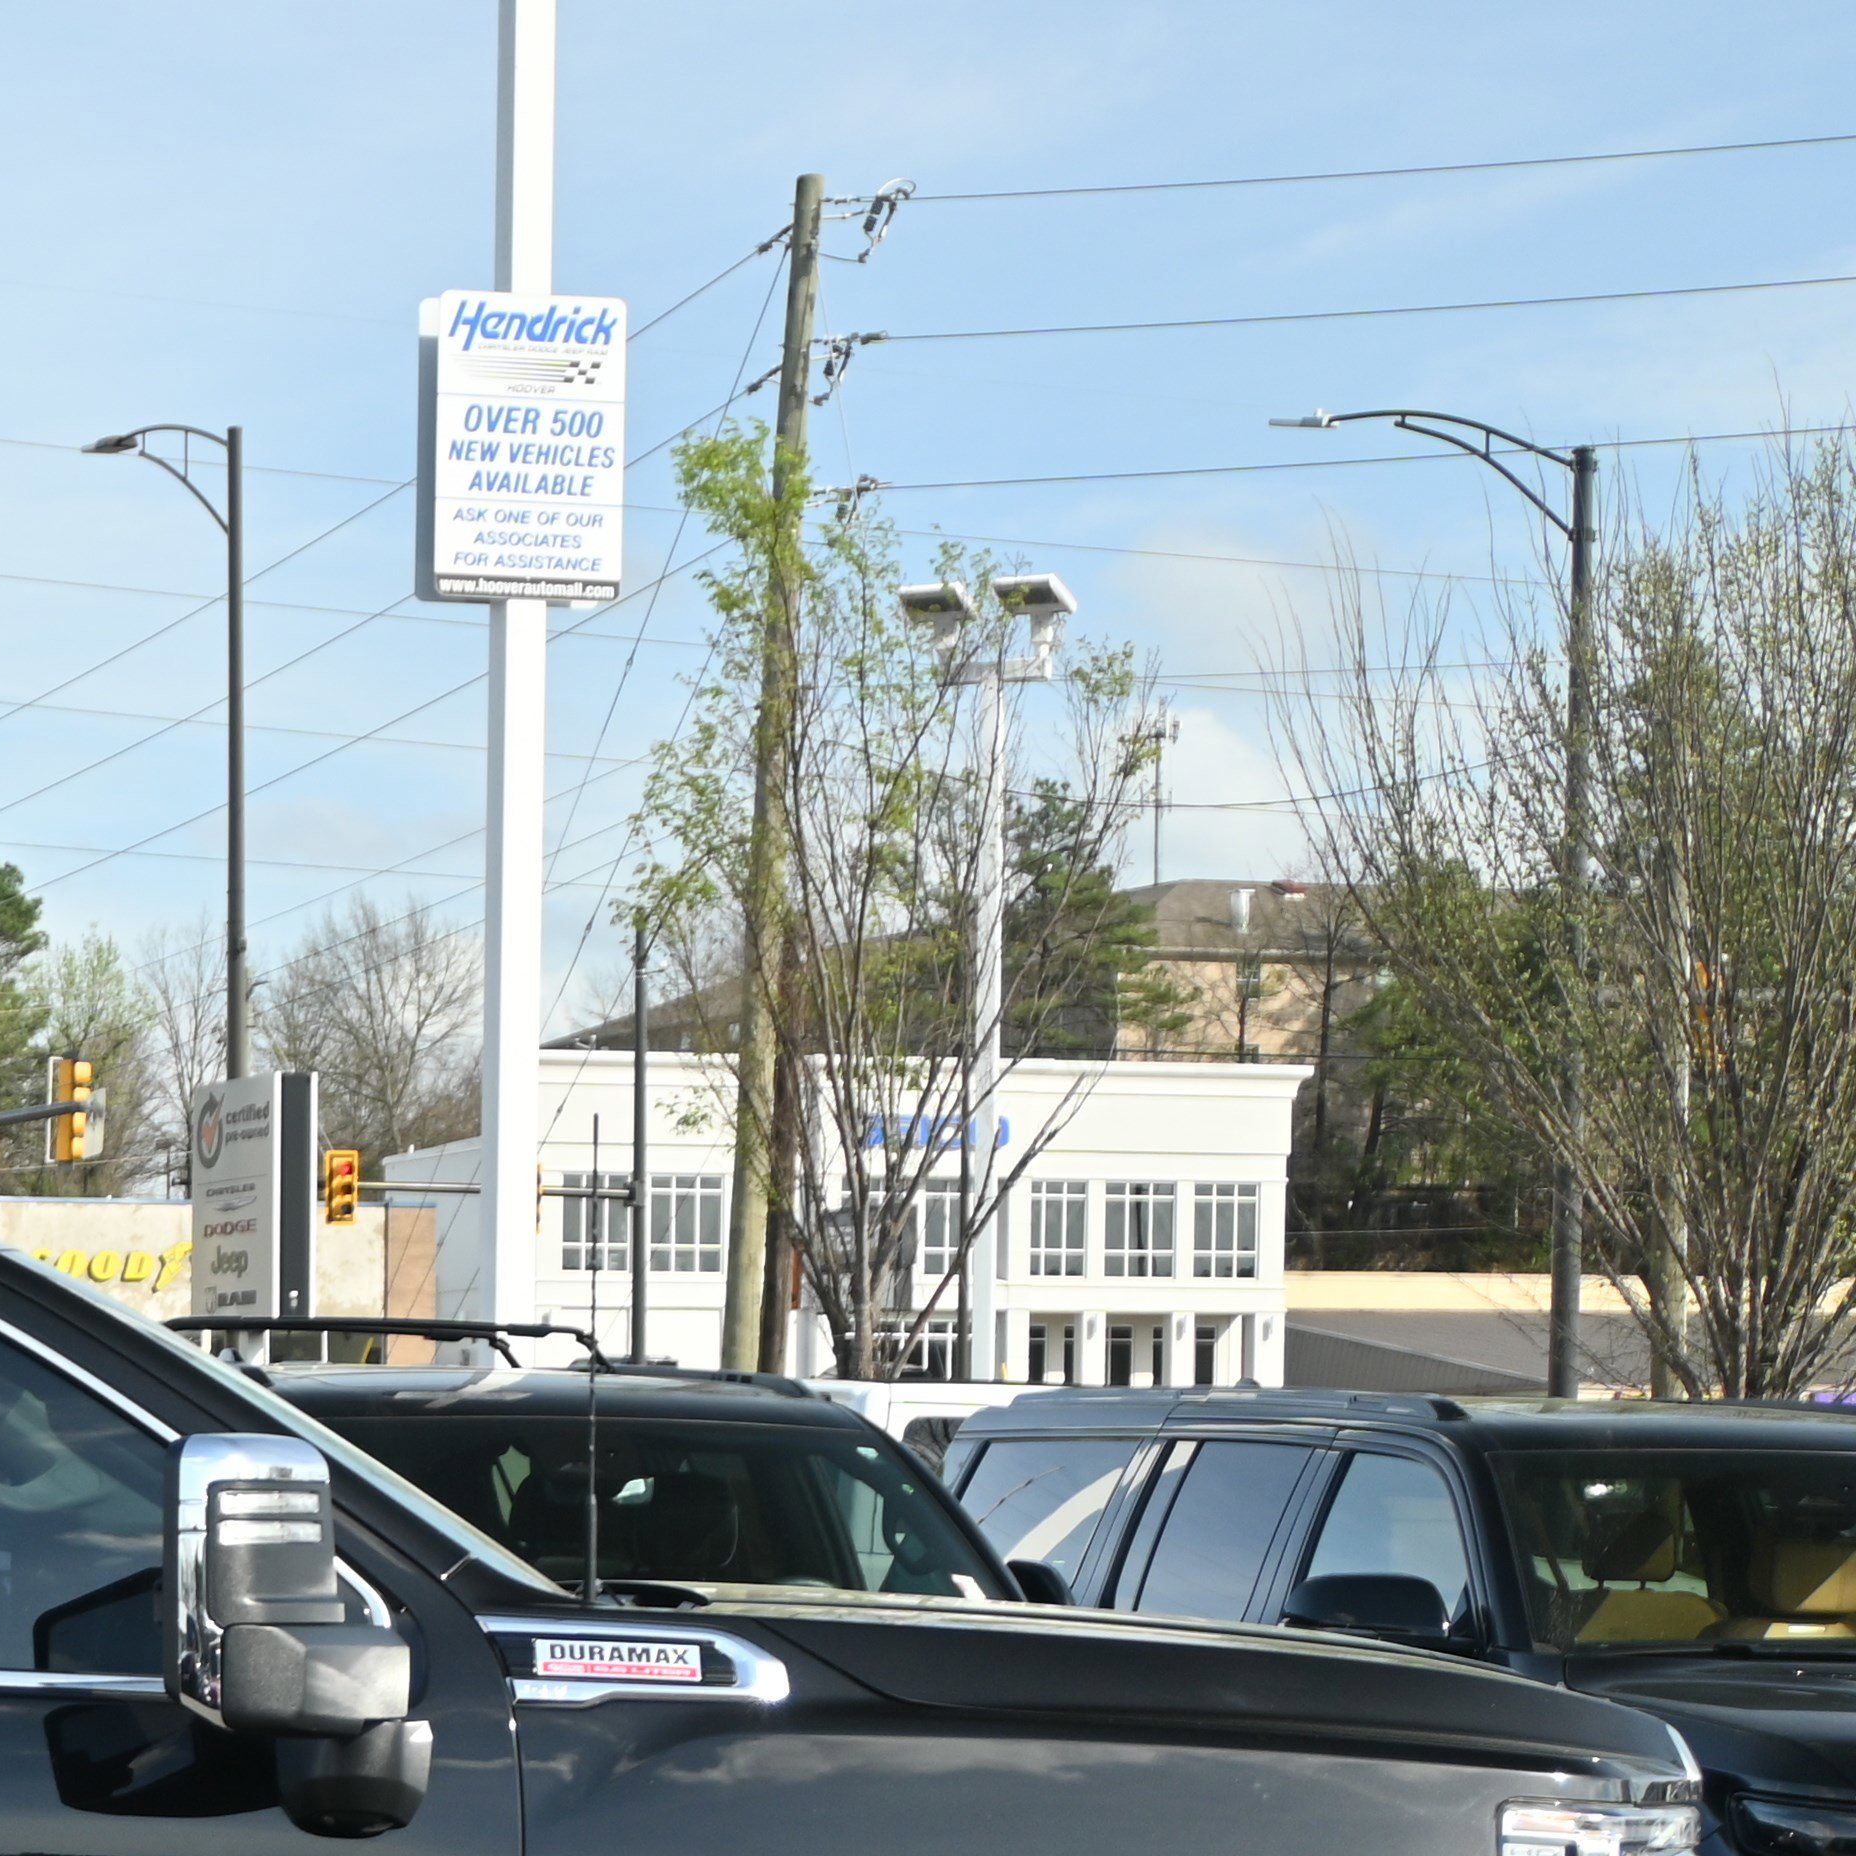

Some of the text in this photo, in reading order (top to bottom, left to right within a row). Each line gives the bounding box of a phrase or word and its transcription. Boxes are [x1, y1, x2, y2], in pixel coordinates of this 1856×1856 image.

[448, 300, 618, 351] Hendrick
[506, 384, 556, 394] HOOVER
[464, 404, 604, 438] OVER 500
[448, 440, 615, 468] NEW VEHICLES
[468, 470, 594, 497] AVAILABLE
[453, 507, 604, 528] ASK ONE OF OUR
[473, 531, 582, 550] ASSOCIATES
[453, 551, 603, 572] FOR ASSISTANCE
[439, 577, 615, 600] www.hooverautomall.com
[225, 1099, 271, 1125] certified
[225, 1121, 271, 1146] pre-owned
[205, 1182, 256, 1199] CHRYSLER
[203, 1217, 258, 1239] DODGE
[210, 1244, 249, 1279] Jeep
[218, 1288, 258, 1307] RAM
[549, 1643, 690, 1666] DURAMAX
